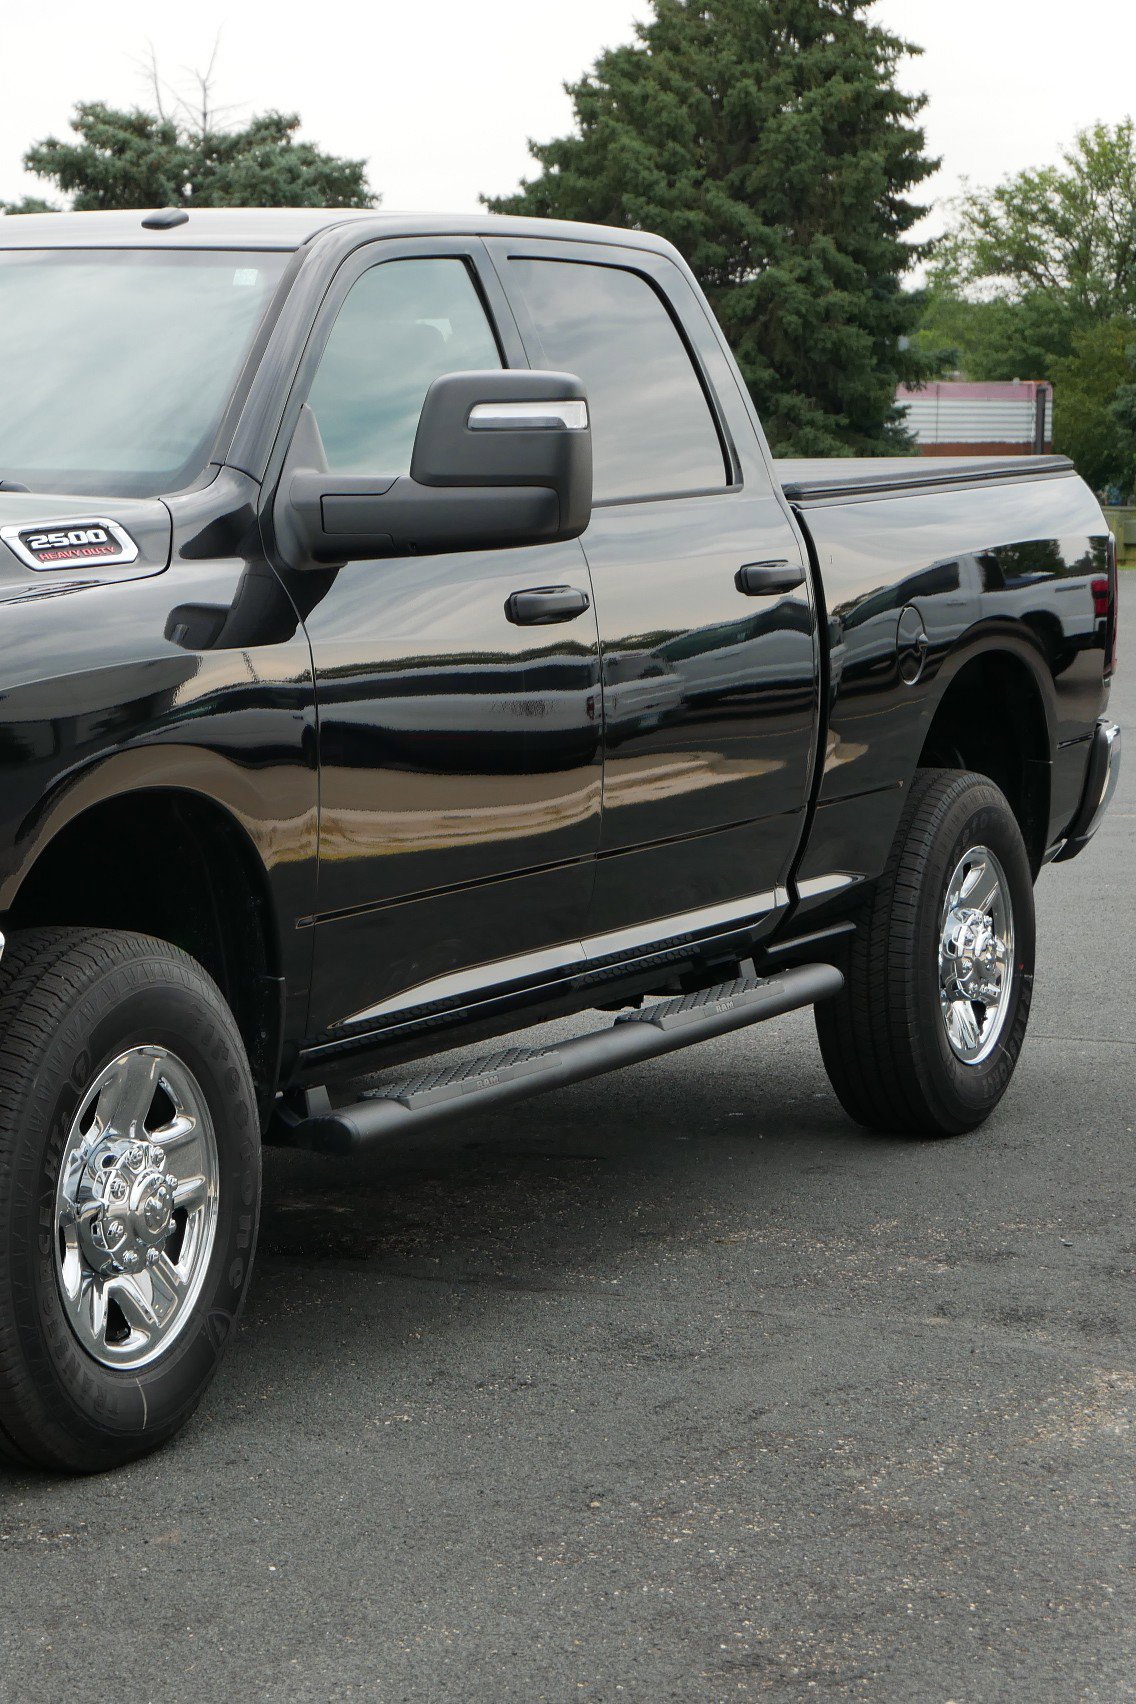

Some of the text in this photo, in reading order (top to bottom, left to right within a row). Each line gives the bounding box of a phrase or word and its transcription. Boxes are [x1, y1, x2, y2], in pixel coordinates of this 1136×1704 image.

[27, 529, 108, 550] 2500
[39, 546, 115, 561] HEAVY DUTY
